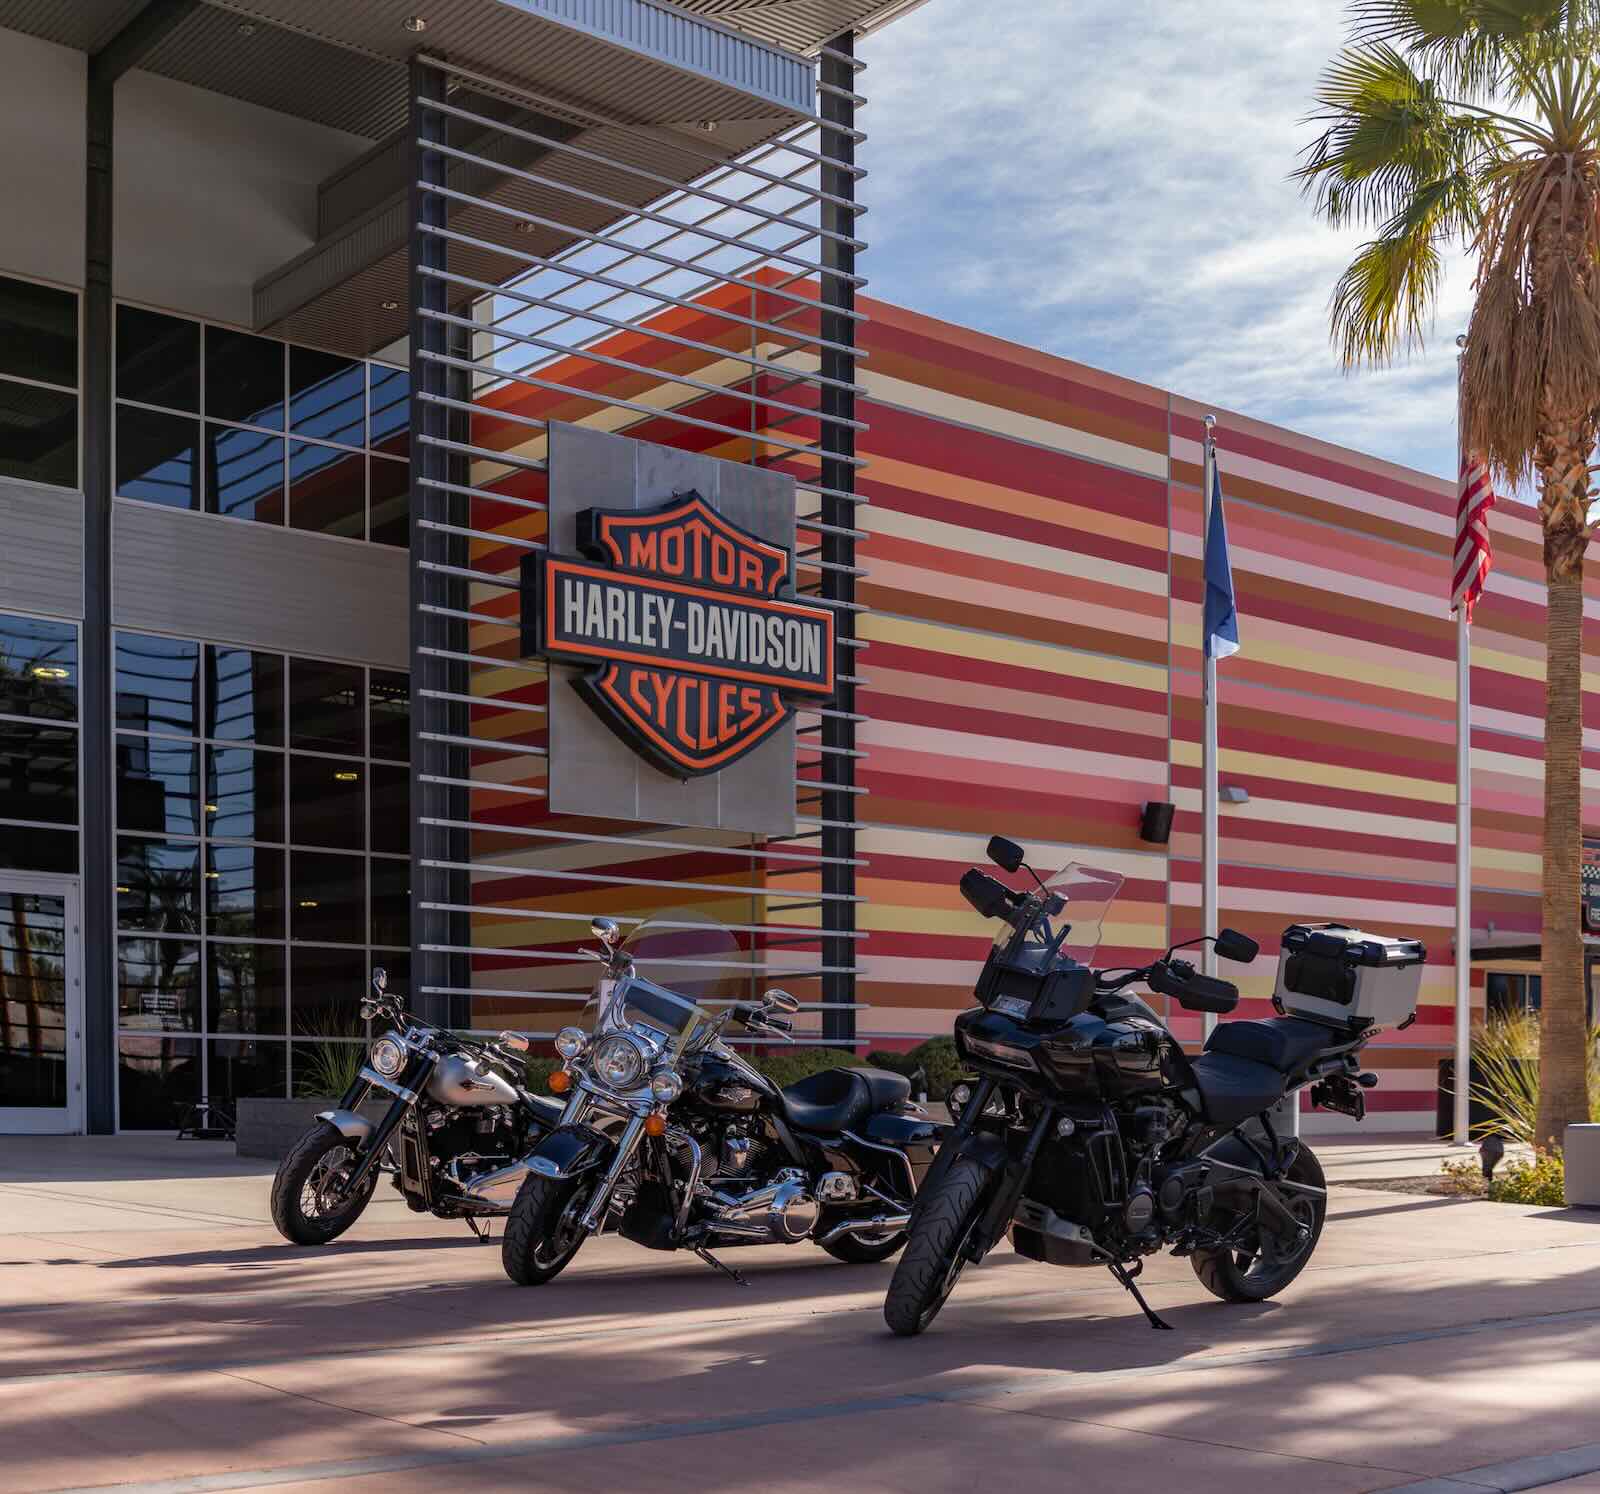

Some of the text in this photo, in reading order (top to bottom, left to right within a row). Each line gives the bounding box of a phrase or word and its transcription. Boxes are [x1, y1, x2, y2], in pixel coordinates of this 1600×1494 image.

[630, 518, 764, 591] MOTOR
[564, 579, 821, 675] HARLEY-DAVIDSON
[630, 671, 763, 750] CYCLES
